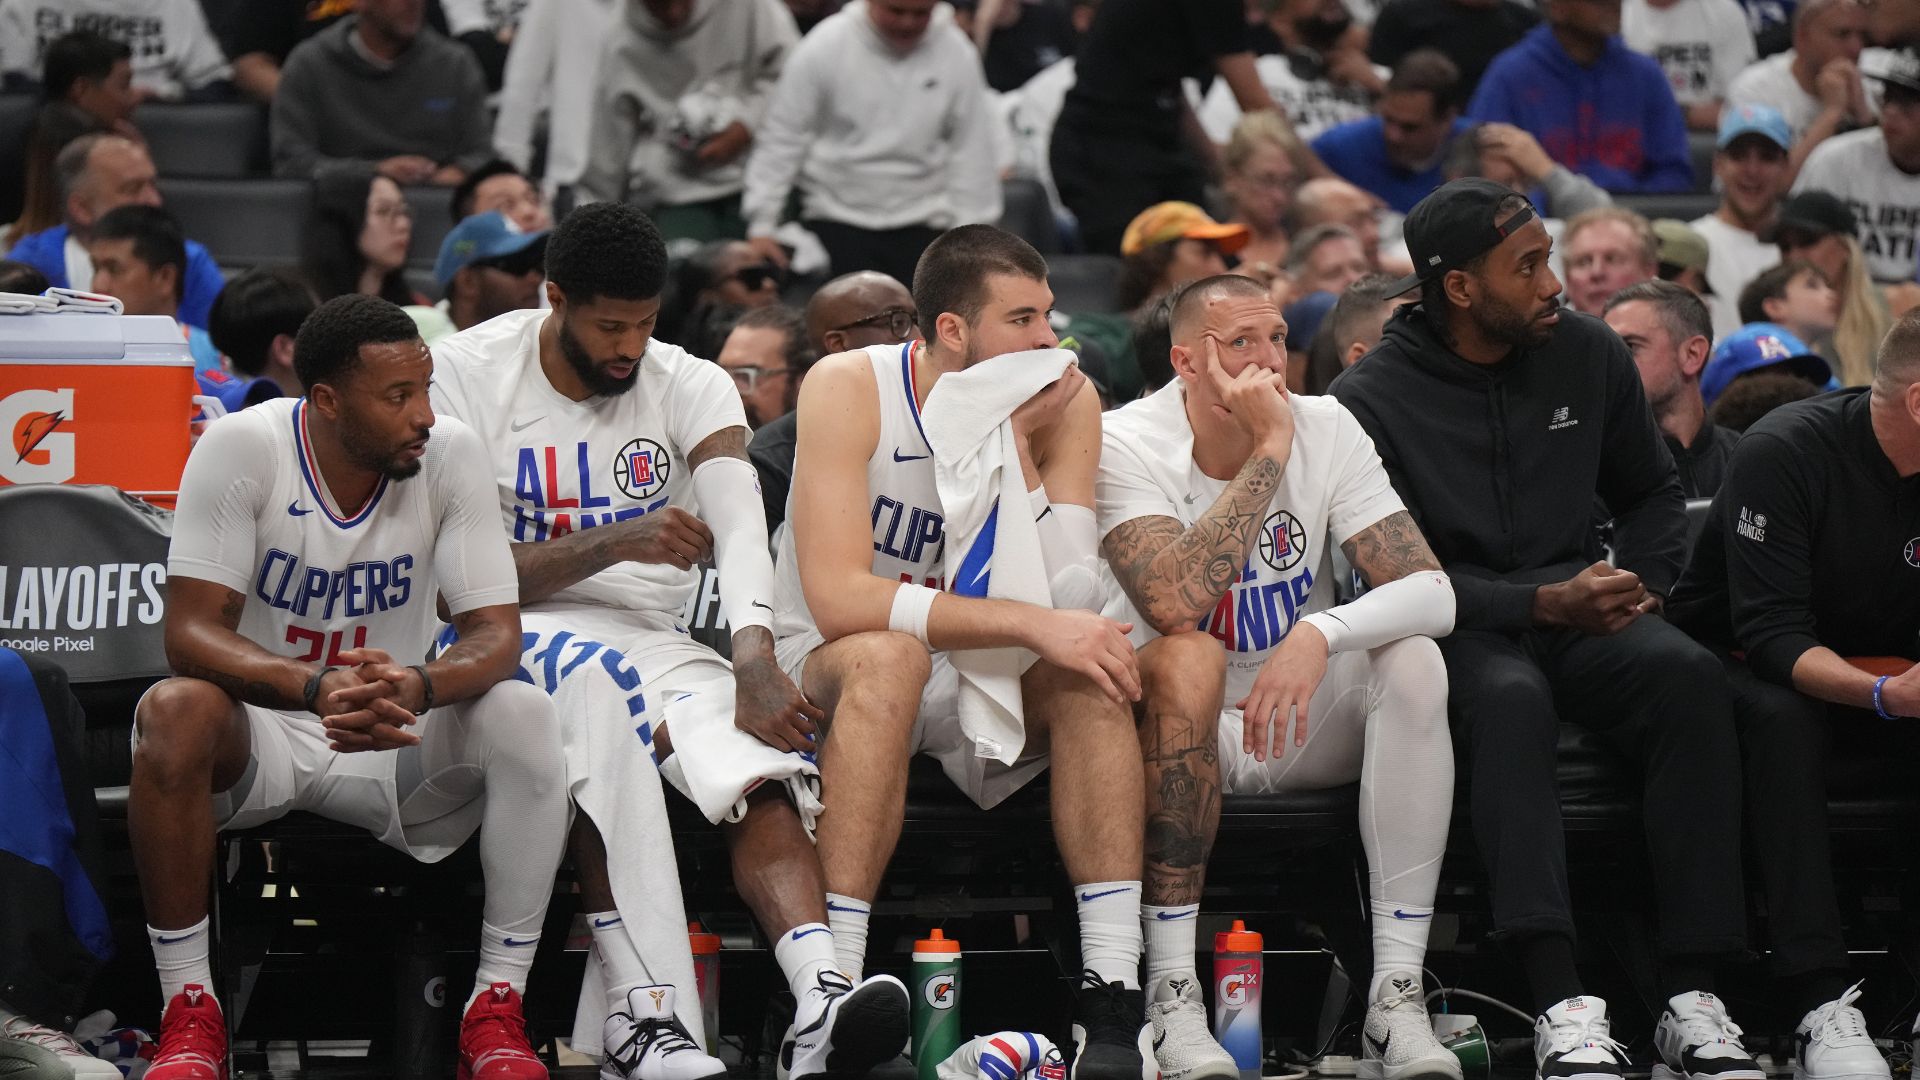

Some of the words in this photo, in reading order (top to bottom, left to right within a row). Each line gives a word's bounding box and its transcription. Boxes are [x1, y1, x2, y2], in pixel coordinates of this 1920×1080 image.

[0, 388, 75, 484] G
[515, 441, 611, 509] ALL
[871, 494, 946, 565] CLIP
[1736, 519, 1765, 542] HANDS
[1739, 505, 1753, 525] ALL
[0, 562, 167, 631] LAYOFFS
[255, 547, 414, 621] CLIPPERS
[1197, 566, 1314, 653] ANDS
[0, 636, 49, 653] oogle
[53, 636, 94, 652] Pixel
[923, 973, 956, 1010] G
